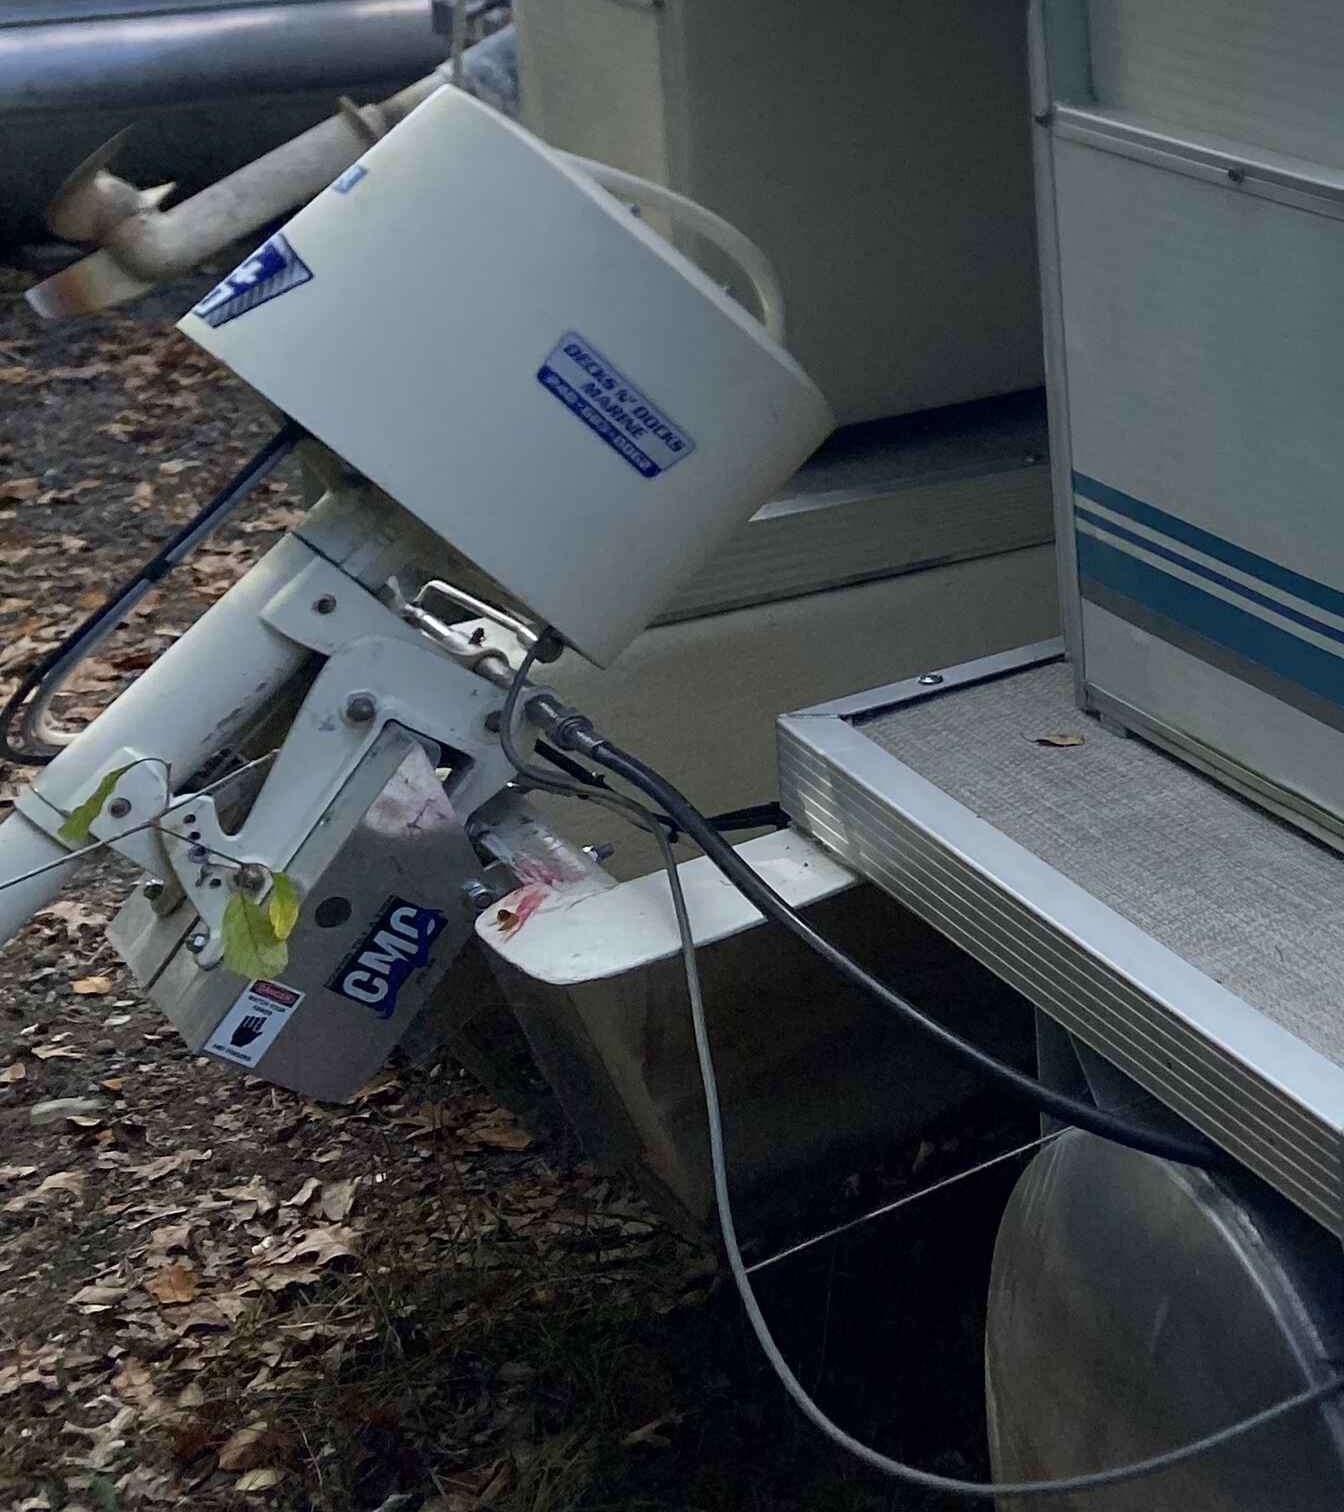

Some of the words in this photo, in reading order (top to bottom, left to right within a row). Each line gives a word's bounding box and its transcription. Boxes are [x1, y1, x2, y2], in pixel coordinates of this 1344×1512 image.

[564, 344, 616, 389] DECKS
[633, 406, 686, 452] DOCKS
[581, 383, 648, 437] MARINE
